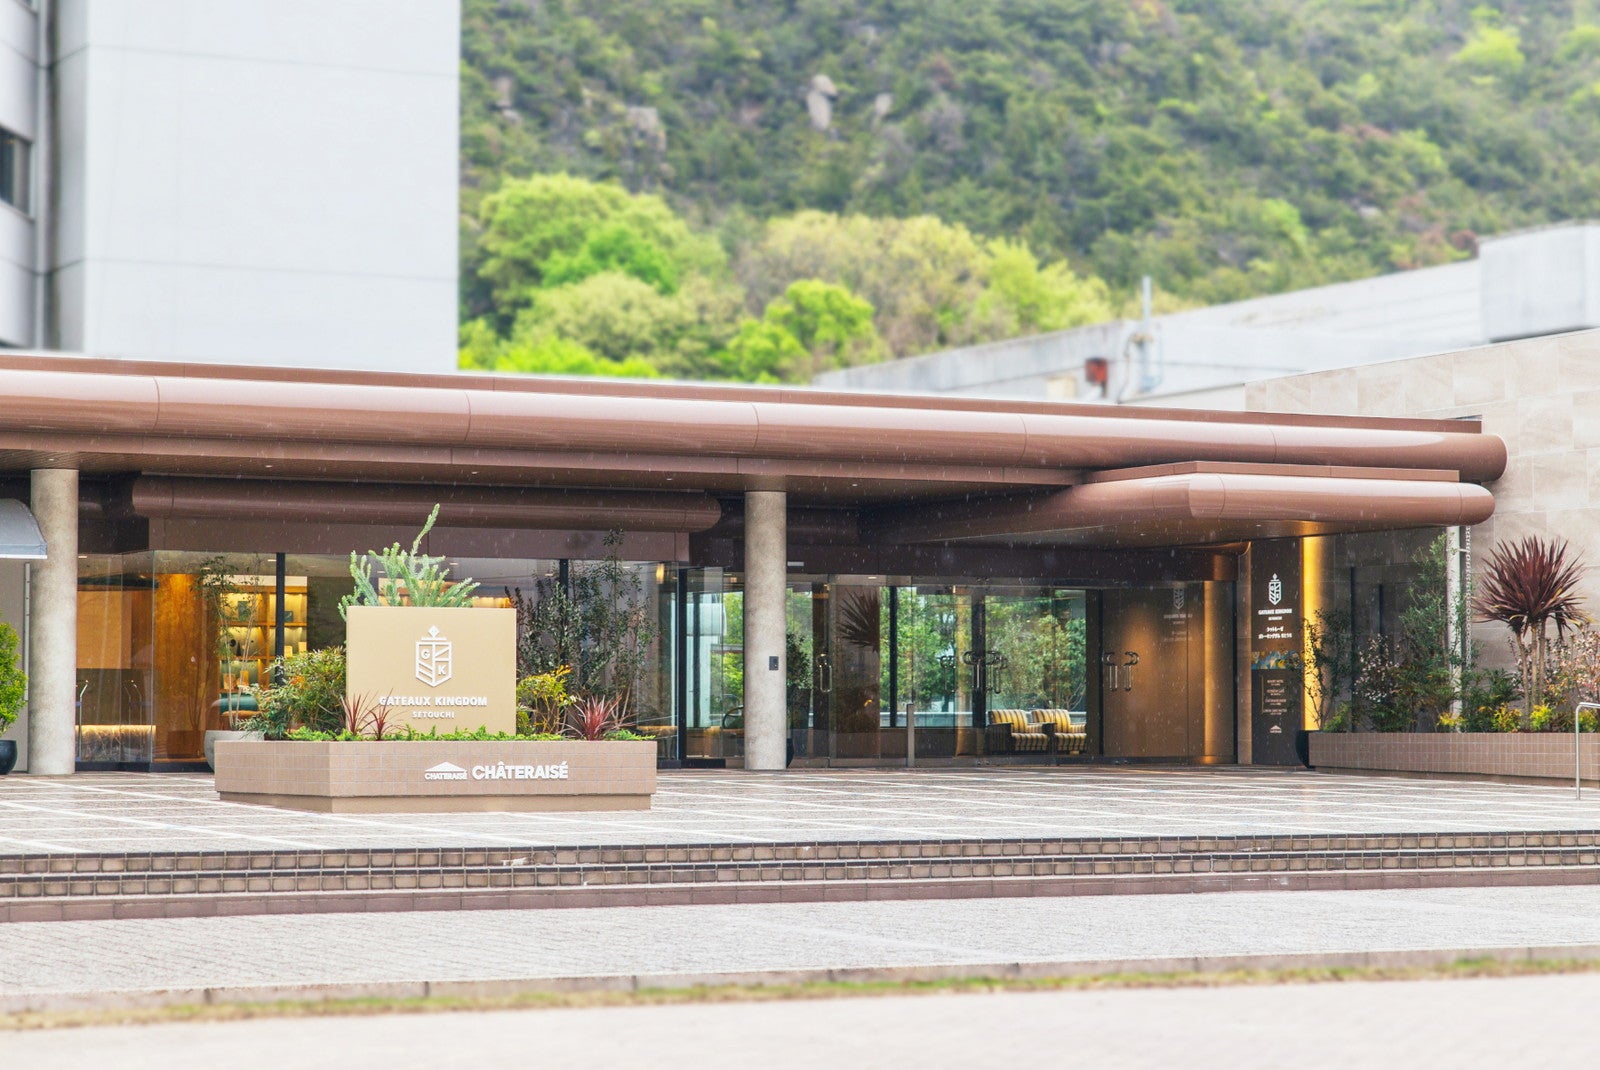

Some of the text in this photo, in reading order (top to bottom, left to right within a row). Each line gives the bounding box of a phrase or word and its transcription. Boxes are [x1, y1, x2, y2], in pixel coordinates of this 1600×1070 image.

[379, 696, 488, 706] GATEAUX KINGDOM
[412, 711, 455, 719] SETOUCHI
[471, 760, 569, 780] CHÂTERAISÉ
